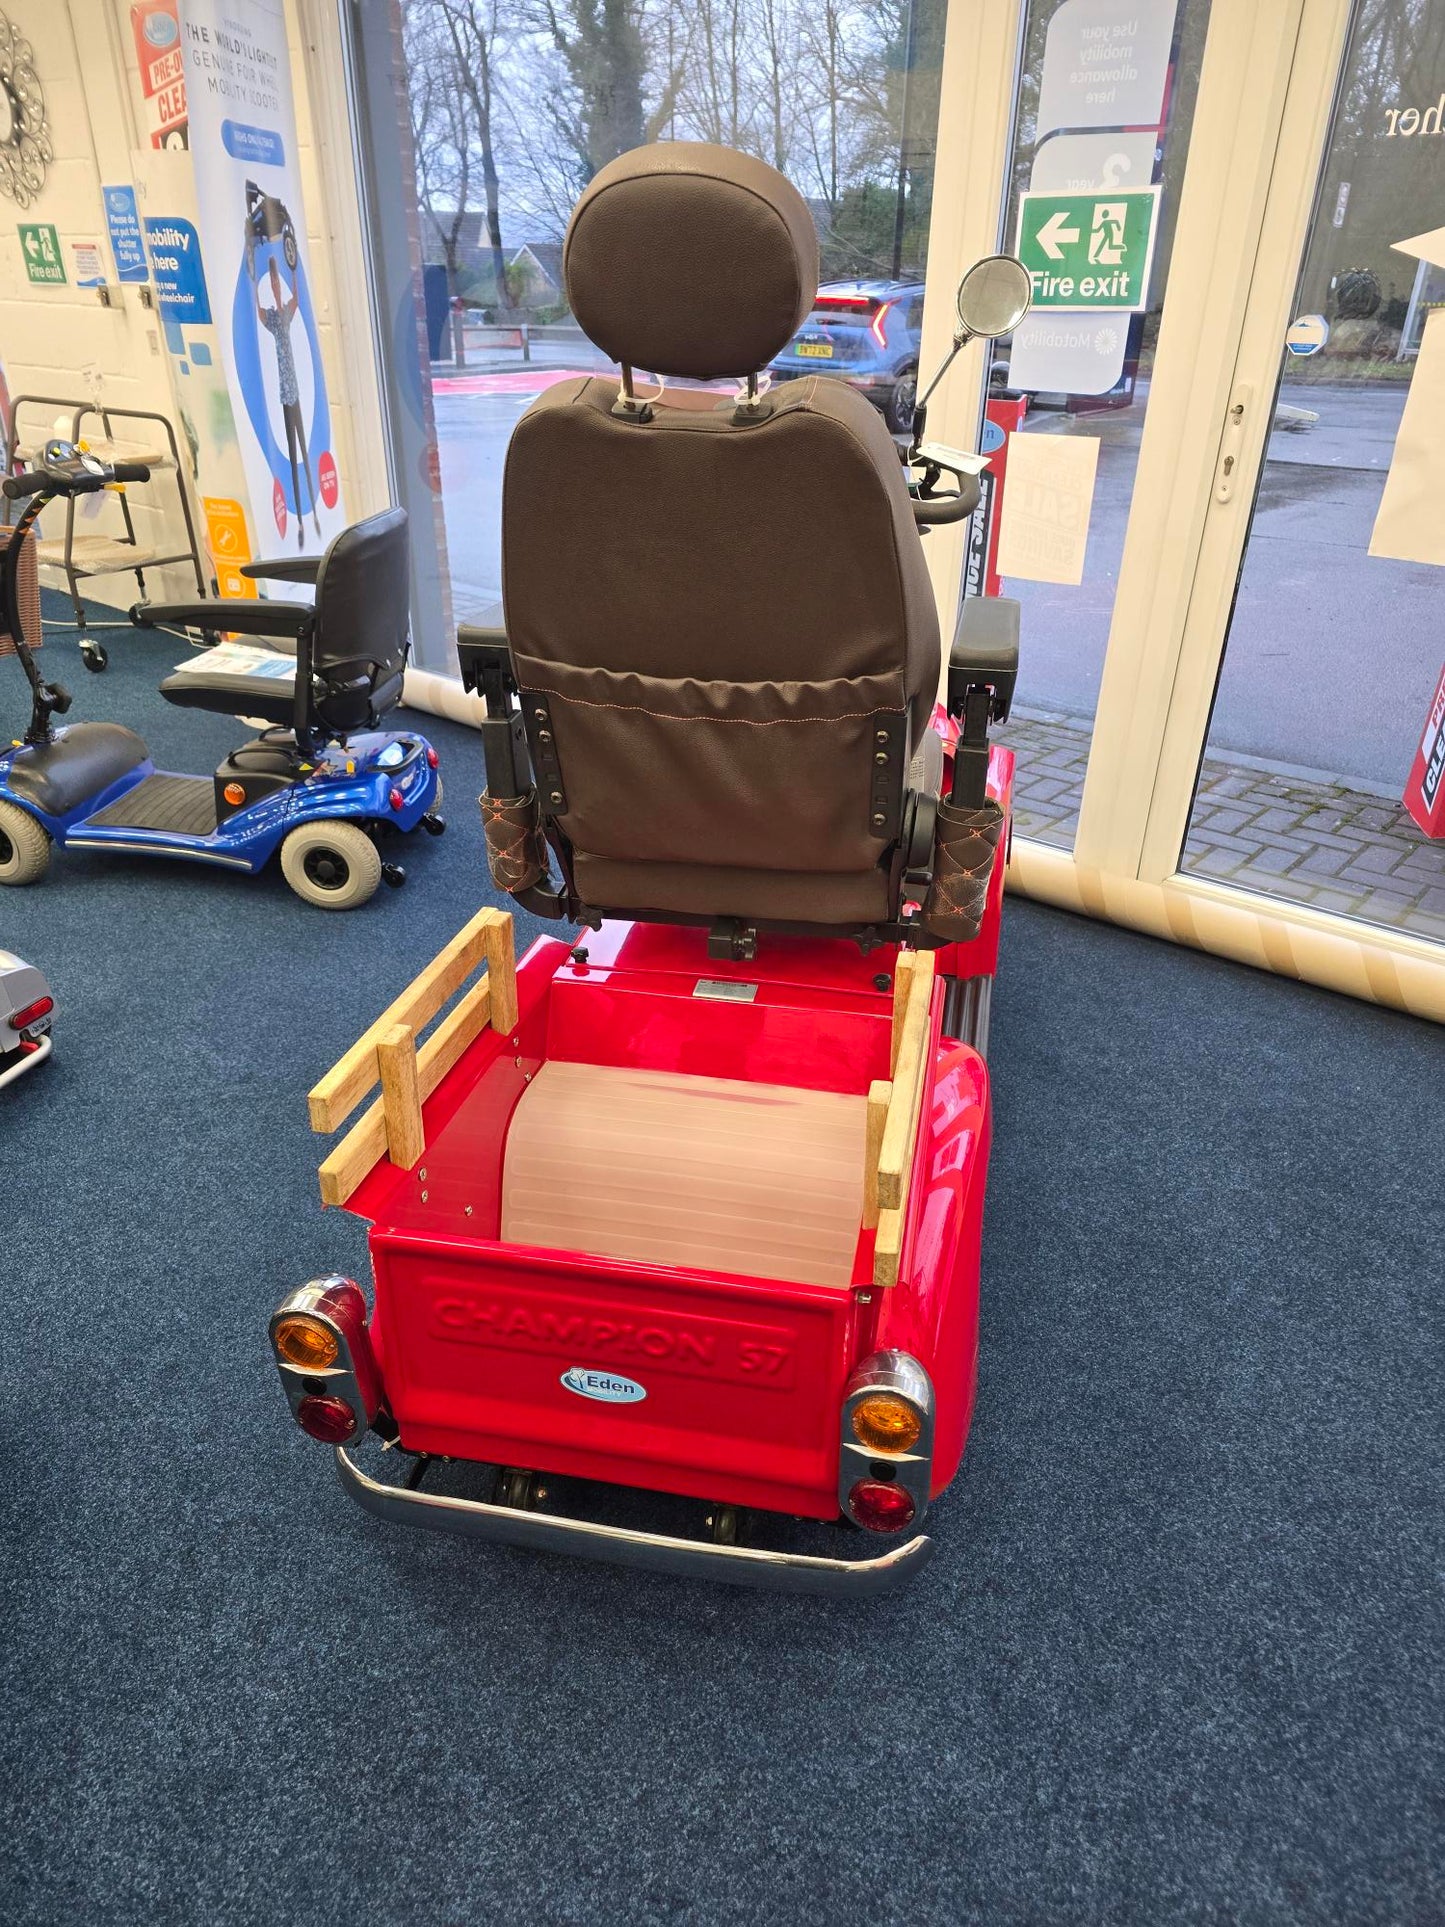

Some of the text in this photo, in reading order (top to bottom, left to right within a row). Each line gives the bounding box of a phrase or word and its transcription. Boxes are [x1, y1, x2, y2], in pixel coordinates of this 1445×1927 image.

[186, 22, 210, 43] THE
[154, 49, 182, 85] PRE-O
[28, 262, 63, 279] Fire exit
[153, 251, 179, 271] here
[1031, 270, 1130, 298] Fire exit
[433, 1298, 791, 1376] CHAMPION 57
[587, 1375, 635, 1394] Eden
